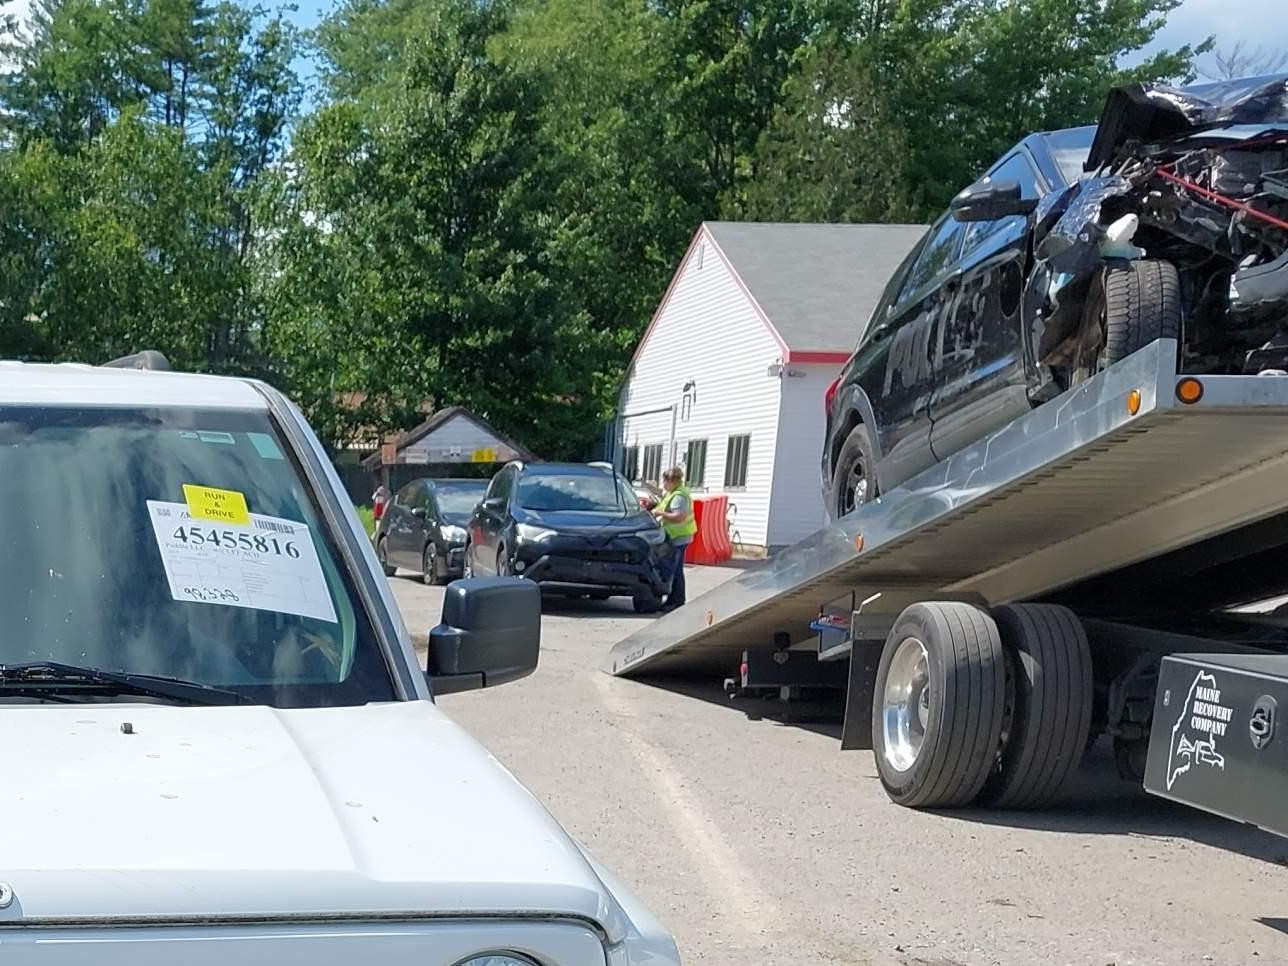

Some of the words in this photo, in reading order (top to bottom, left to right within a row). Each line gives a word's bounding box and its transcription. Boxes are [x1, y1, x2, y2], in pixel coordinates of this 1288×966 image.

[204, 491, 226, 501] RUN
[204, 508, 235, 519] DRIVE
[173, 525, 300, 559] 45455816
[1195, 686, 1221, 703] MAINE
[1193, 701, 1233, 722] RECOVERY
[1191, 716, 1227, 737] COMPANY
